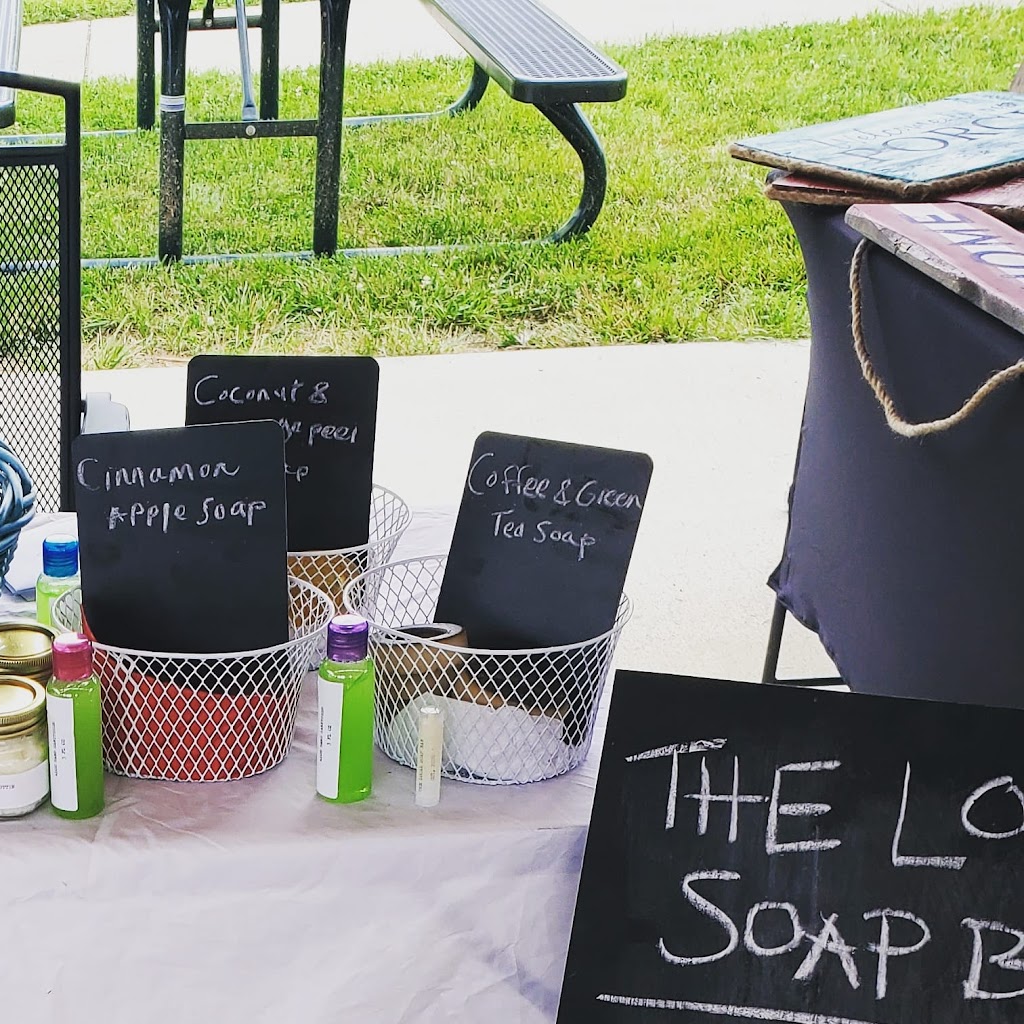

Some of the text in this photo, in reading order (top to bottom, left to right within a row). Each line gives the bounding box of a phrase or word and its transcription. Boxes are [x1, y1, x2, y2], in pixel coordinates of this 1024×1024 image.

[836, 108, 1024, 163] PORC
[194, 374, 304, 406] Coconut
[307, 421, 358, 447] peel
[77, 458, 240, 492] Cinnamon
[468, 452, 643, 509] Coffee & Green
[491, 509, 596, 562] Tea Soap
[625, 737, 842, 855] THE
[658, 869, 932, 1001] SOAP
